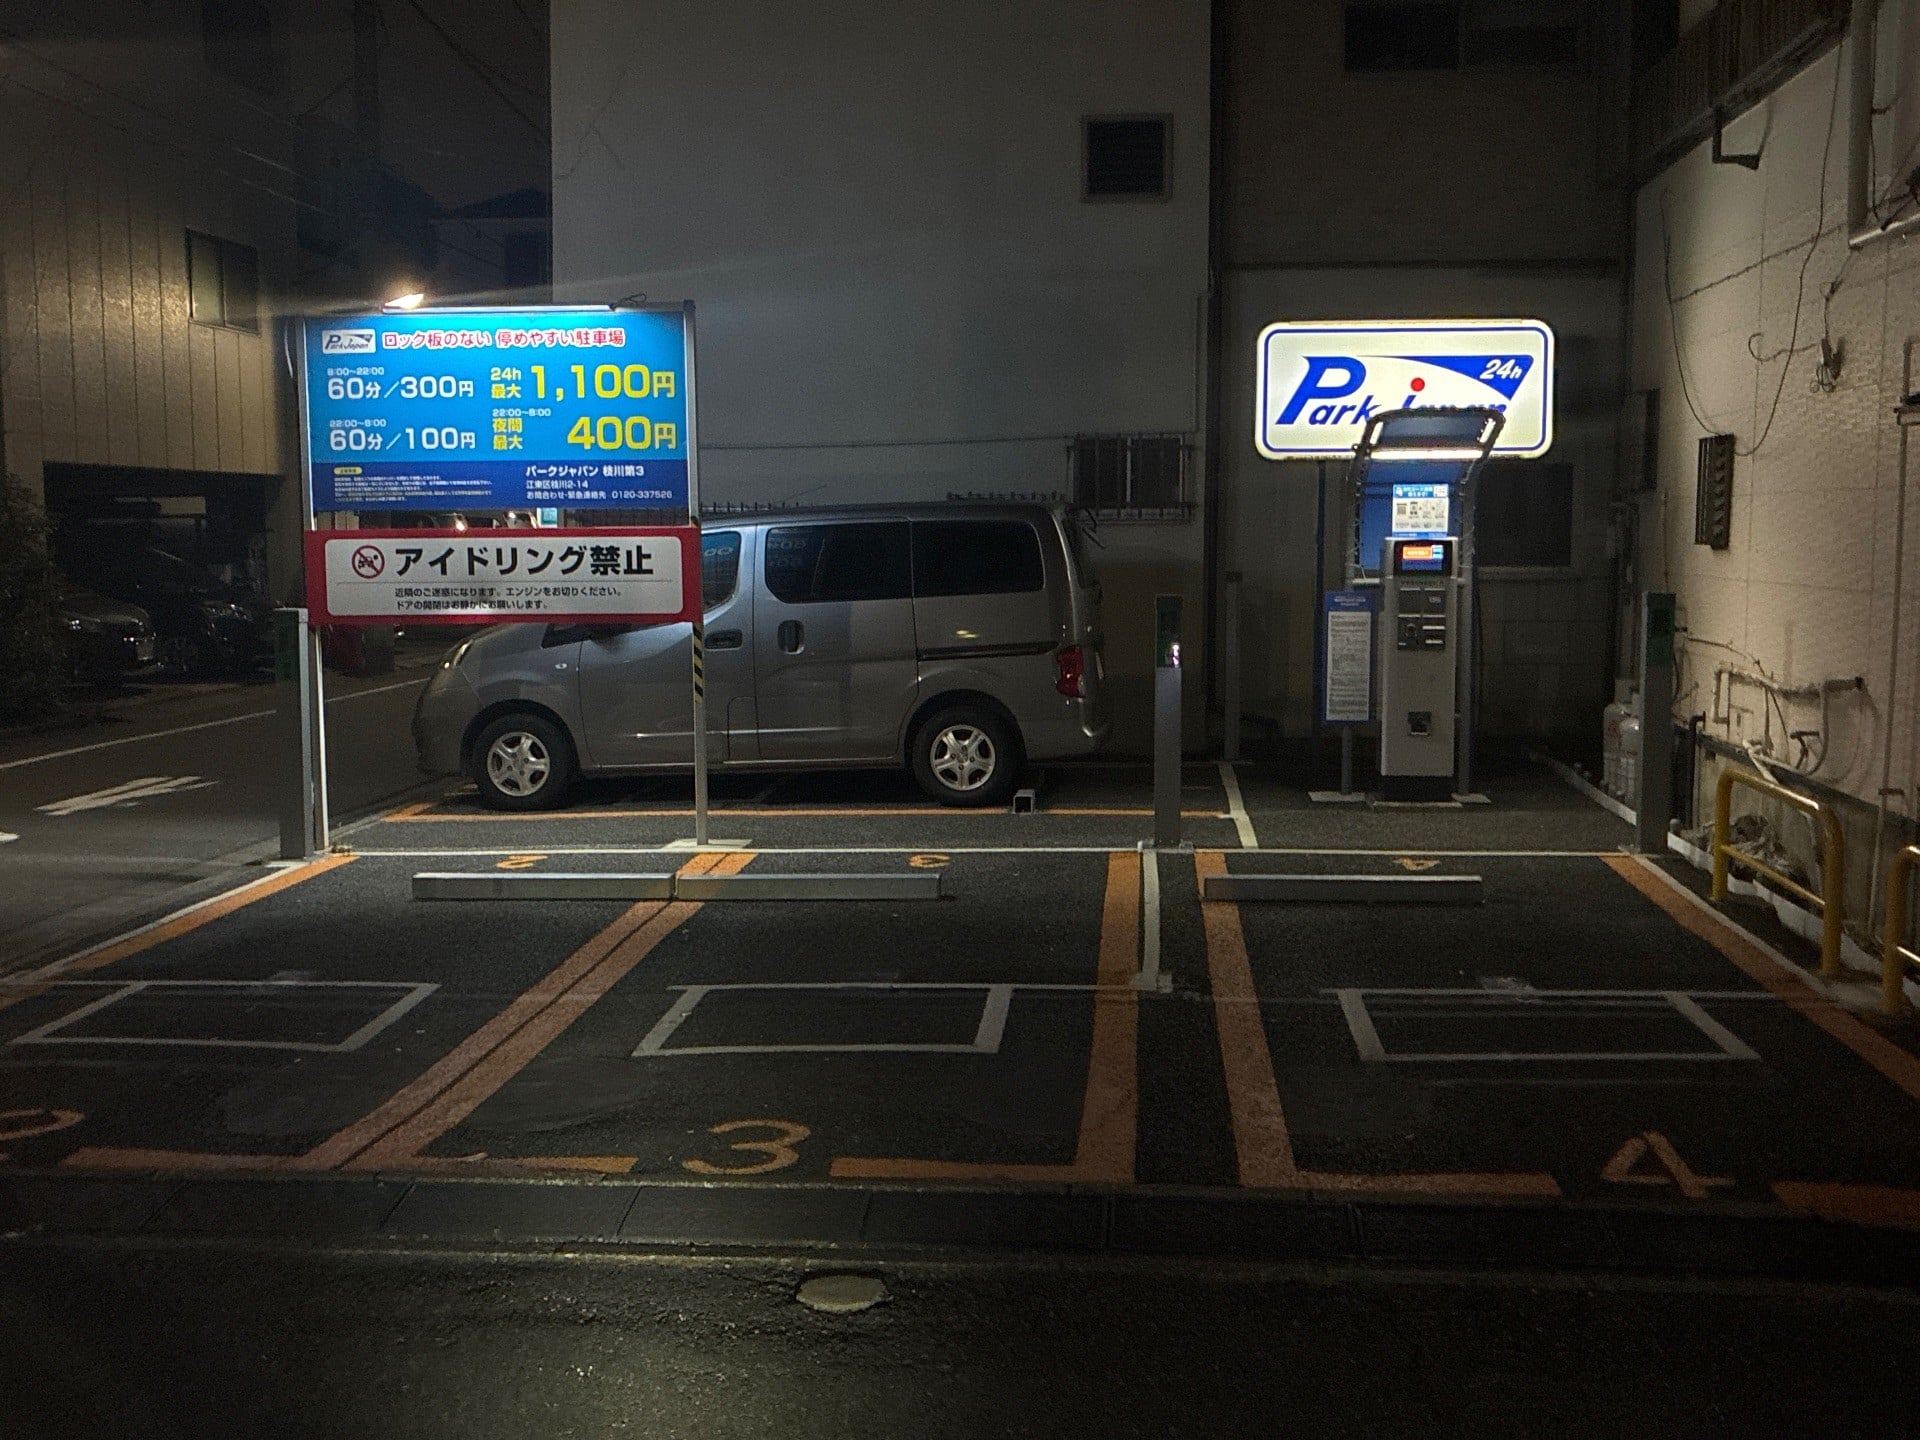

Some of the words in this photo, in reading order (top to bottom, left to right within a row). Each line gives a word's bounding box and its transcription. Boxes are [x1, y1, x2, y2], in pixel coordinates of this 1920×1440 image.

[384, 332, 491, 348] ロック板のない
[497, 330, 624, 347] 停めやすい駐車場
[490, 367, 521, 381] 24h
[1480, 359, 1521, 379] 24h
[491, 383, 521, 399] 最大
[531, 364, 675, 401] 1,100円
[1275, 356, 1381, 425] Park
[492, 418, 523, 433] 夜間
[567, 416, 676, 450] 400円
[493, 434, 523, 450] 最大
[525, 465, 599, 477] パークジャパン
[395, 545, 654, 576] アイドリング禁止
[682, 1119, 811, 1175] 3
[1600, 1130, 1733, 1199] 4
